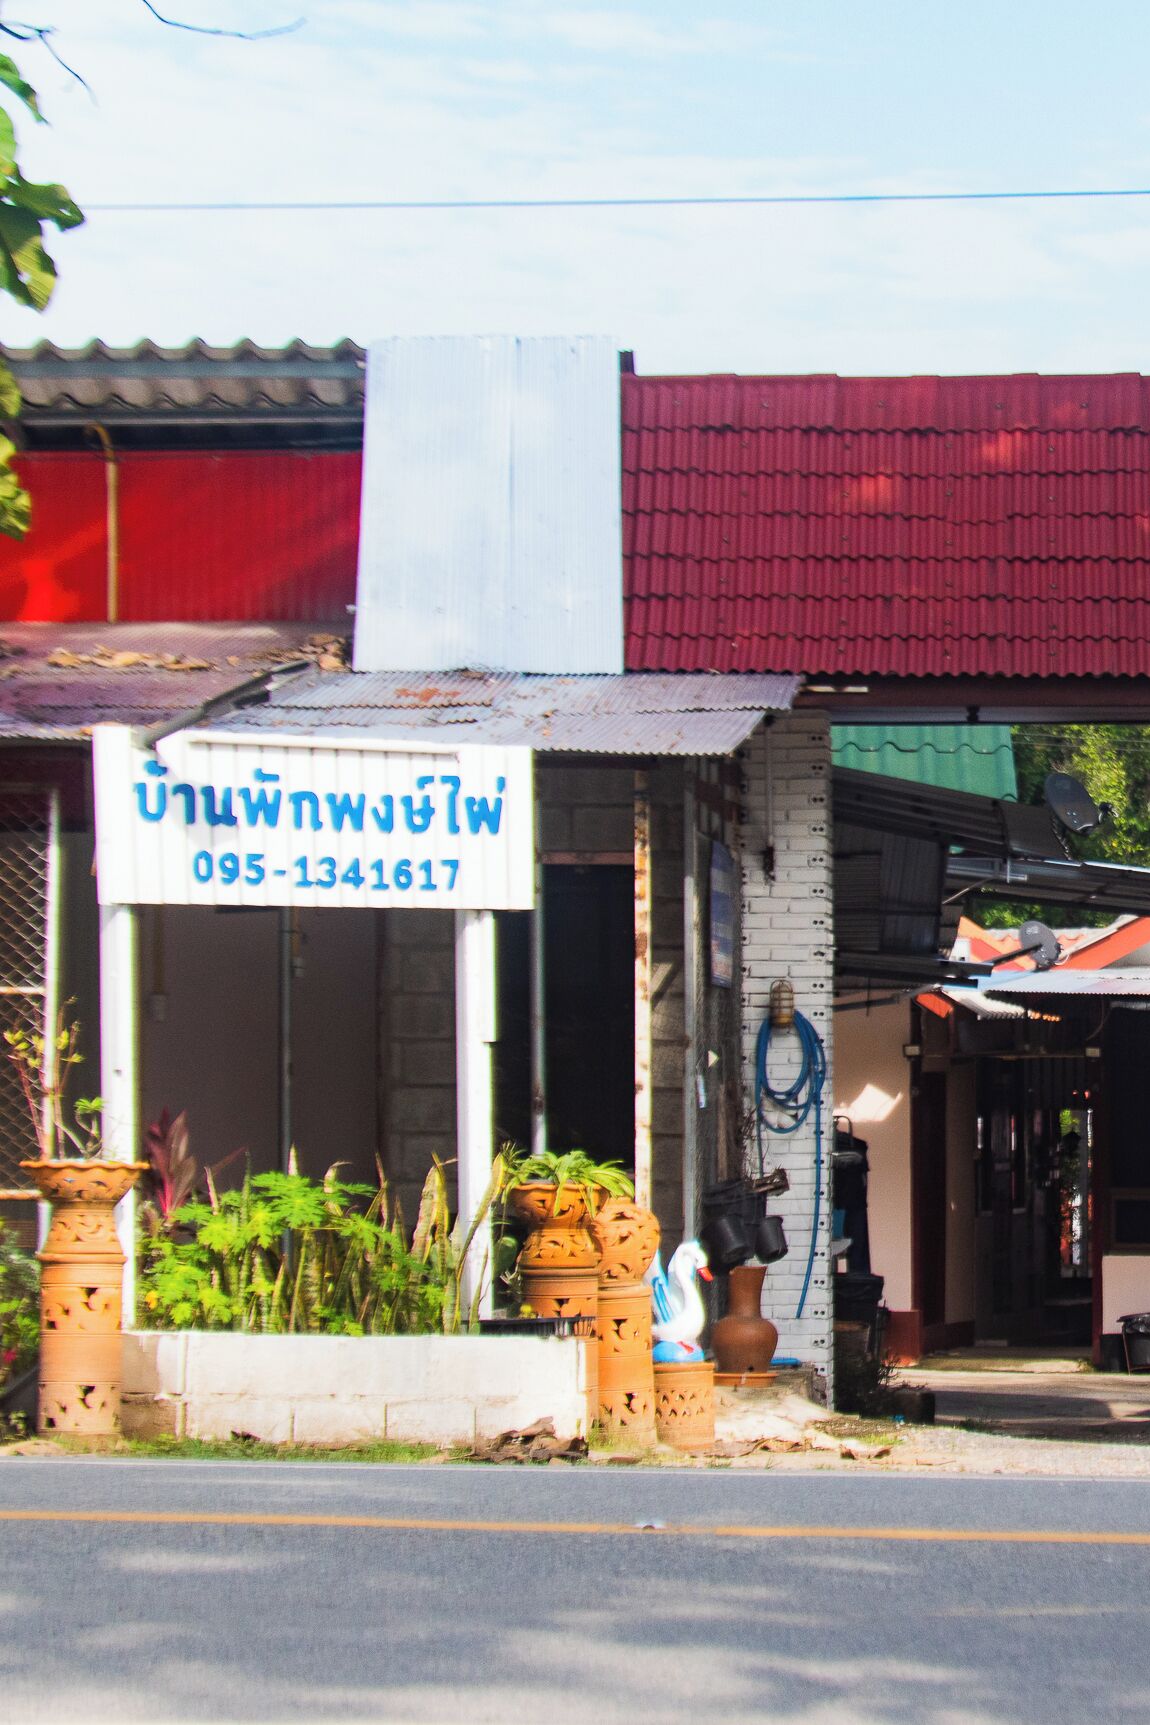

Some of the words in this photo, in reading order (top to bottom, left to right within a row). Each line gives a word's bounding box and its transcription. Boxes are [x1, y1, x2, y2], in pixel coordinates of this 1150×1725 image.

[133, 759, 506, 836] บ้านพักพงษ์ไผ่
[192, 849, 460, 892] 095-1341617
